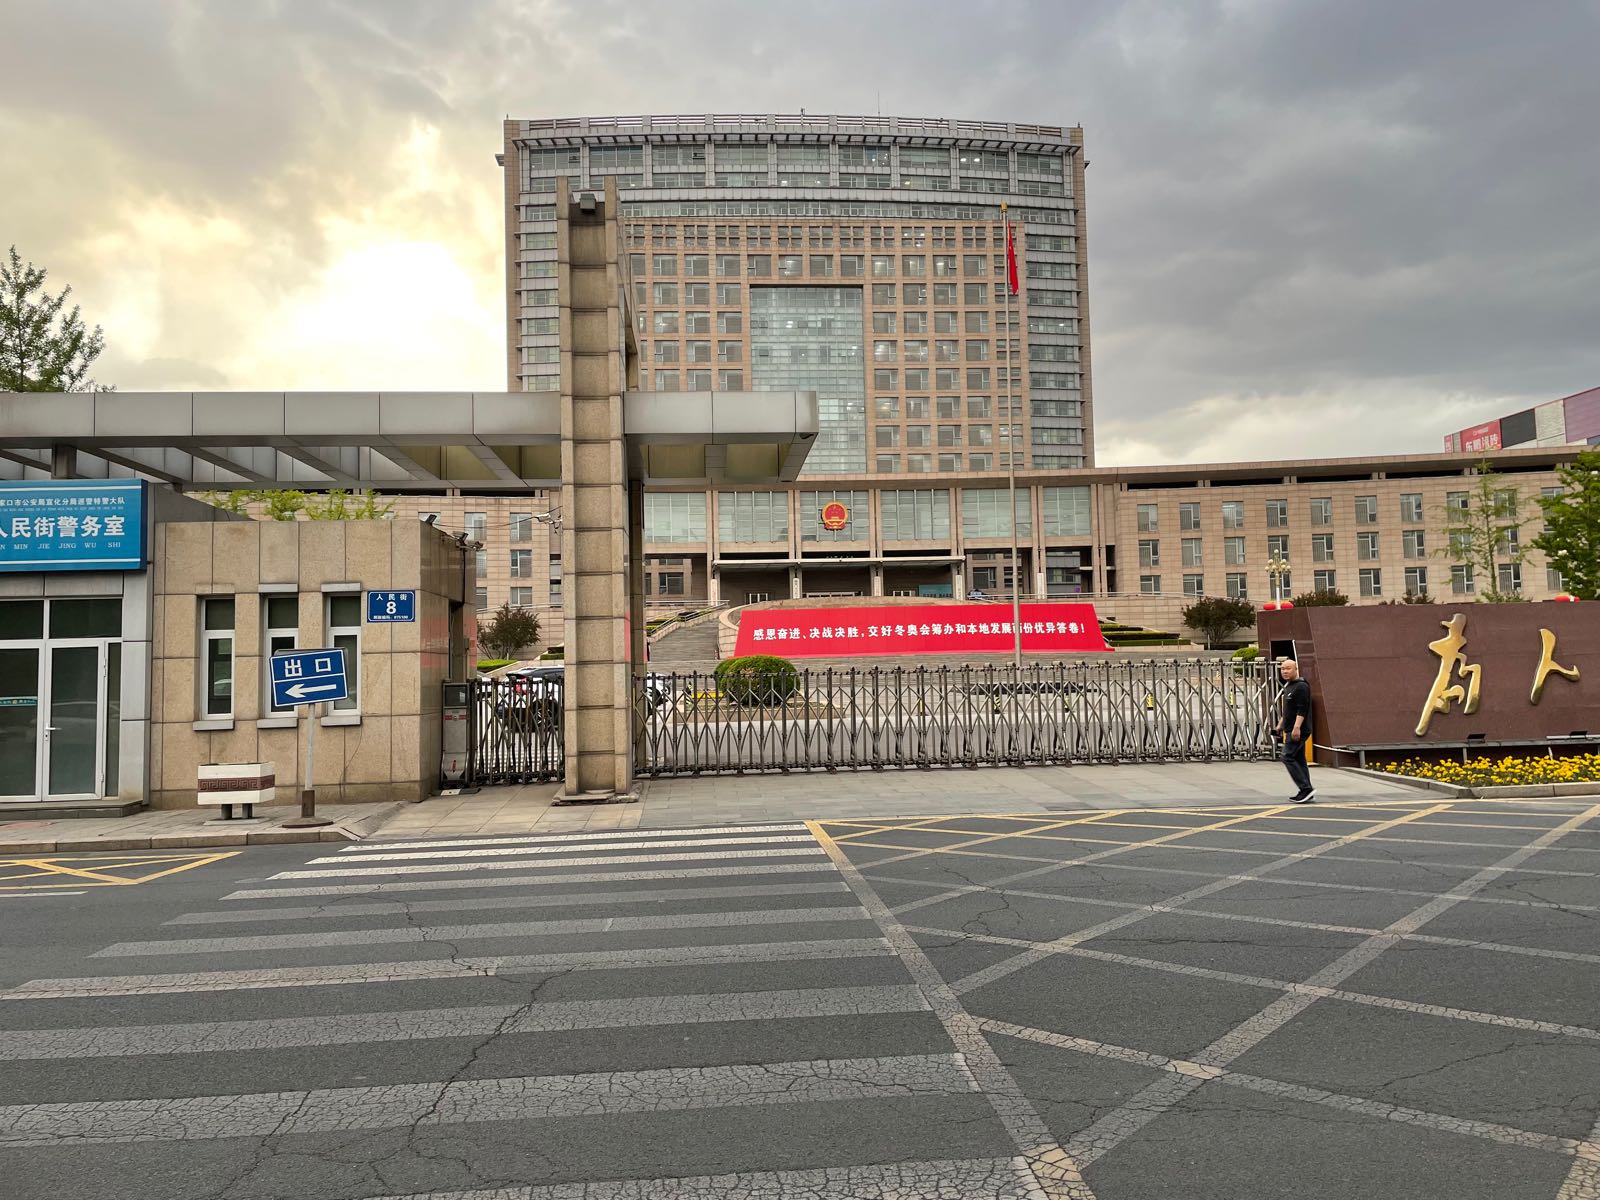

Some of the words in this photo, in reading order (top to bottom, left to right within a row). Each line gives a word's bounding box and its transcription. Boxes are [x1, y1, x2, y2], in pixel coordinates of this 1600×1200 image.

[376, 593, 407, 601] 人民街
[386, 601, 397, 615] 8
[284, 657, 332, 678] 出口
